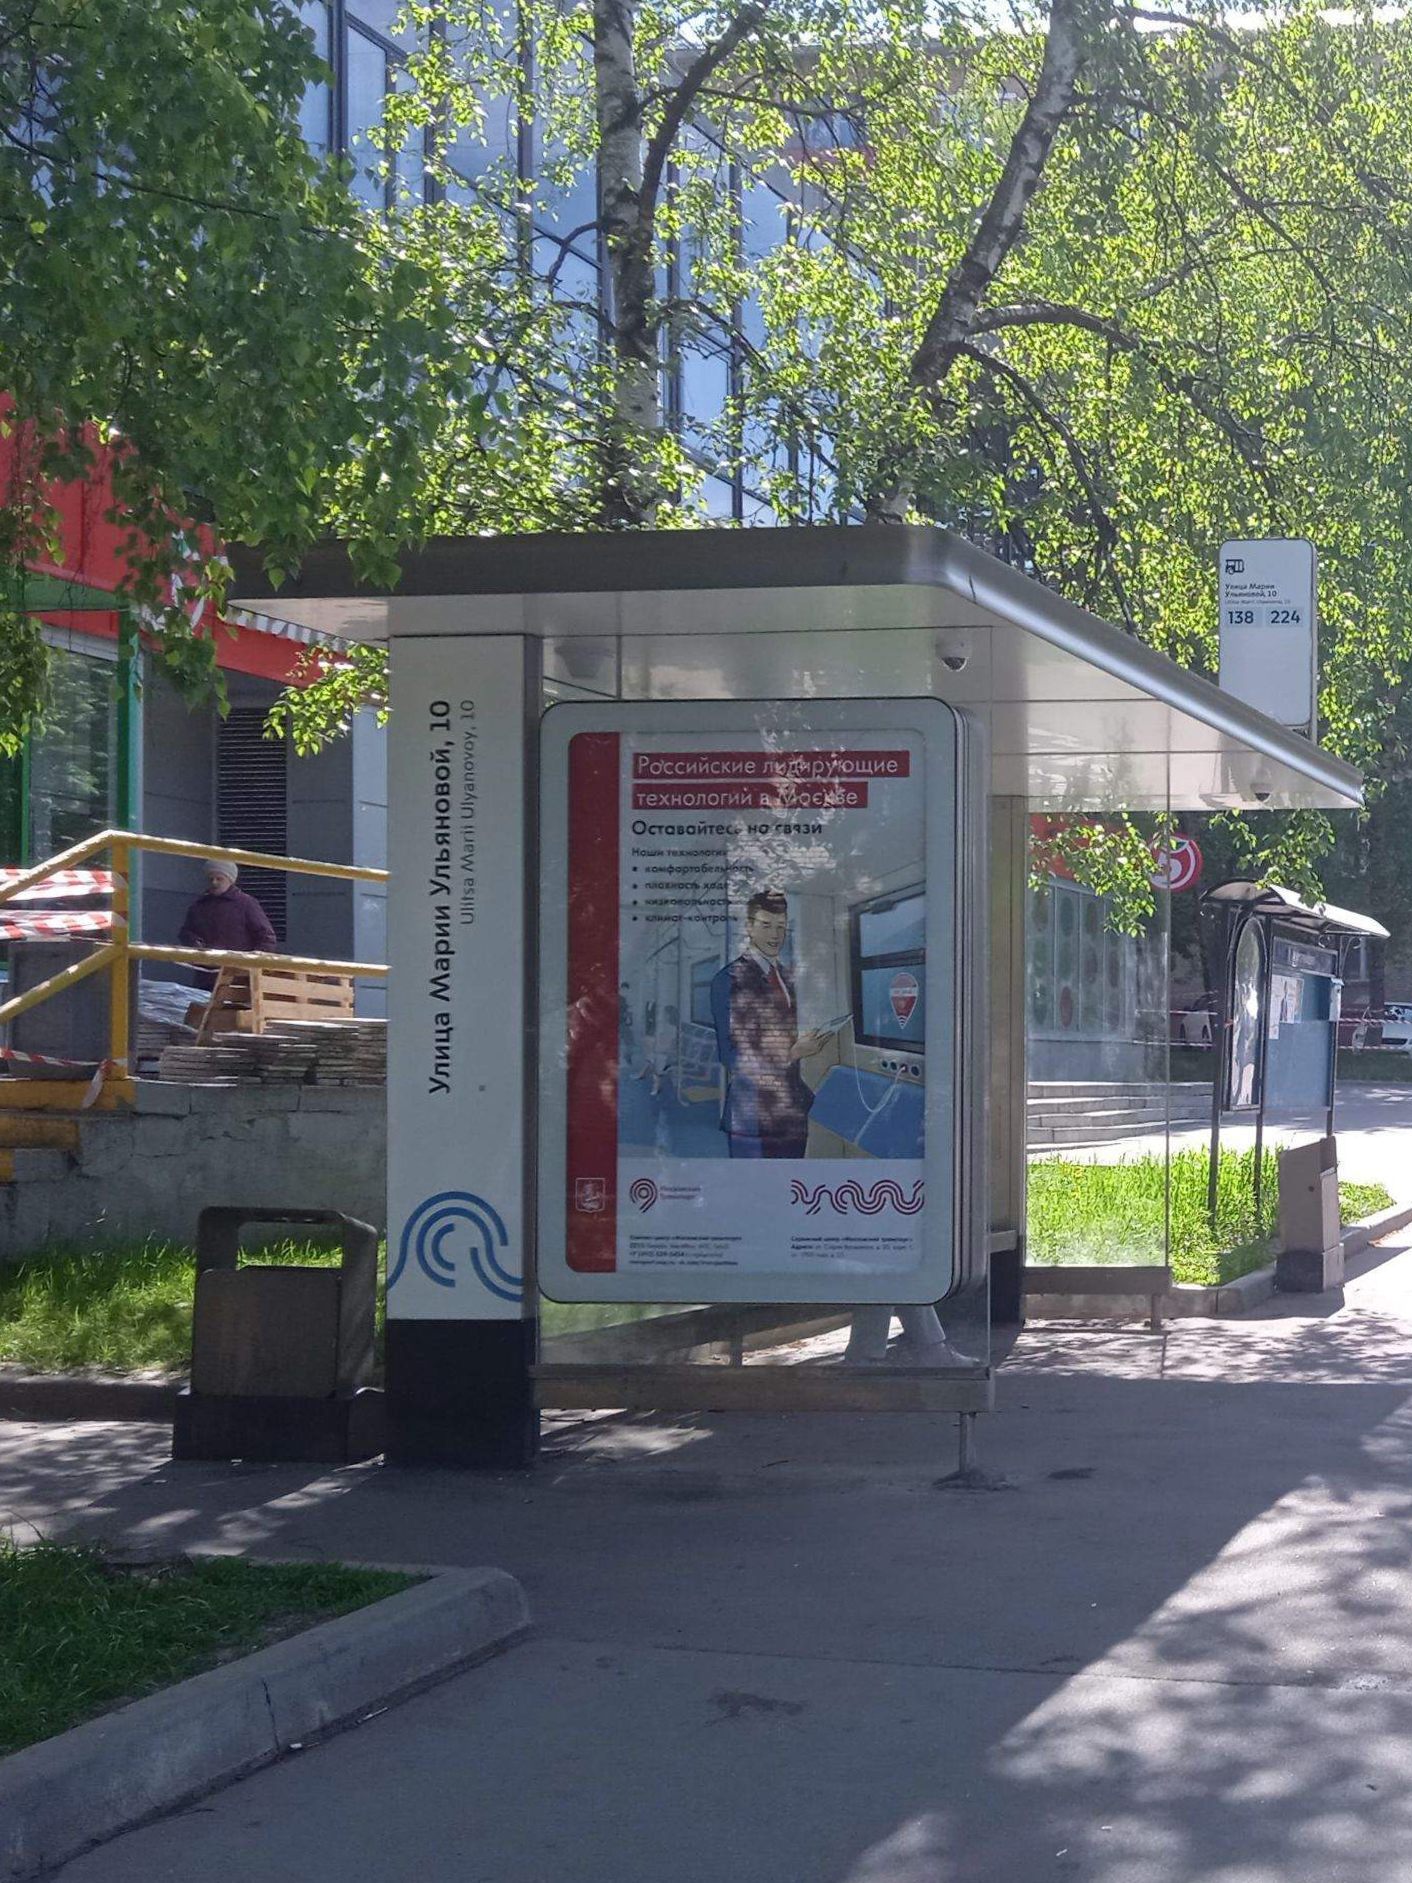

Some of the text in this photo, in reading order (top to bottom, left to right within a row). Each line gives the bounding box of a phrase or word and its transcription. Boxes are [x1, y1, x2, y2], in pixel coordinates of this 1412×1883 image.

[1228, 610, 1254, 625] 138
[1270, 610, 1301, 624] 224
[637, 755, 898, 778] Российские лидирующие
[636, 787, 753, 807] технологий
[760, 793, 770, 806] в
[460, 699, 479, 925] Ulitsa Marii Ulyanovoy, 10
[748, 823, 770, 835] на
[775, 823, 823, 835] связи
[631, 847, 665, 858] Наши
[429, 700, 455, 1094] Улица Марии Ульяновой, 10
